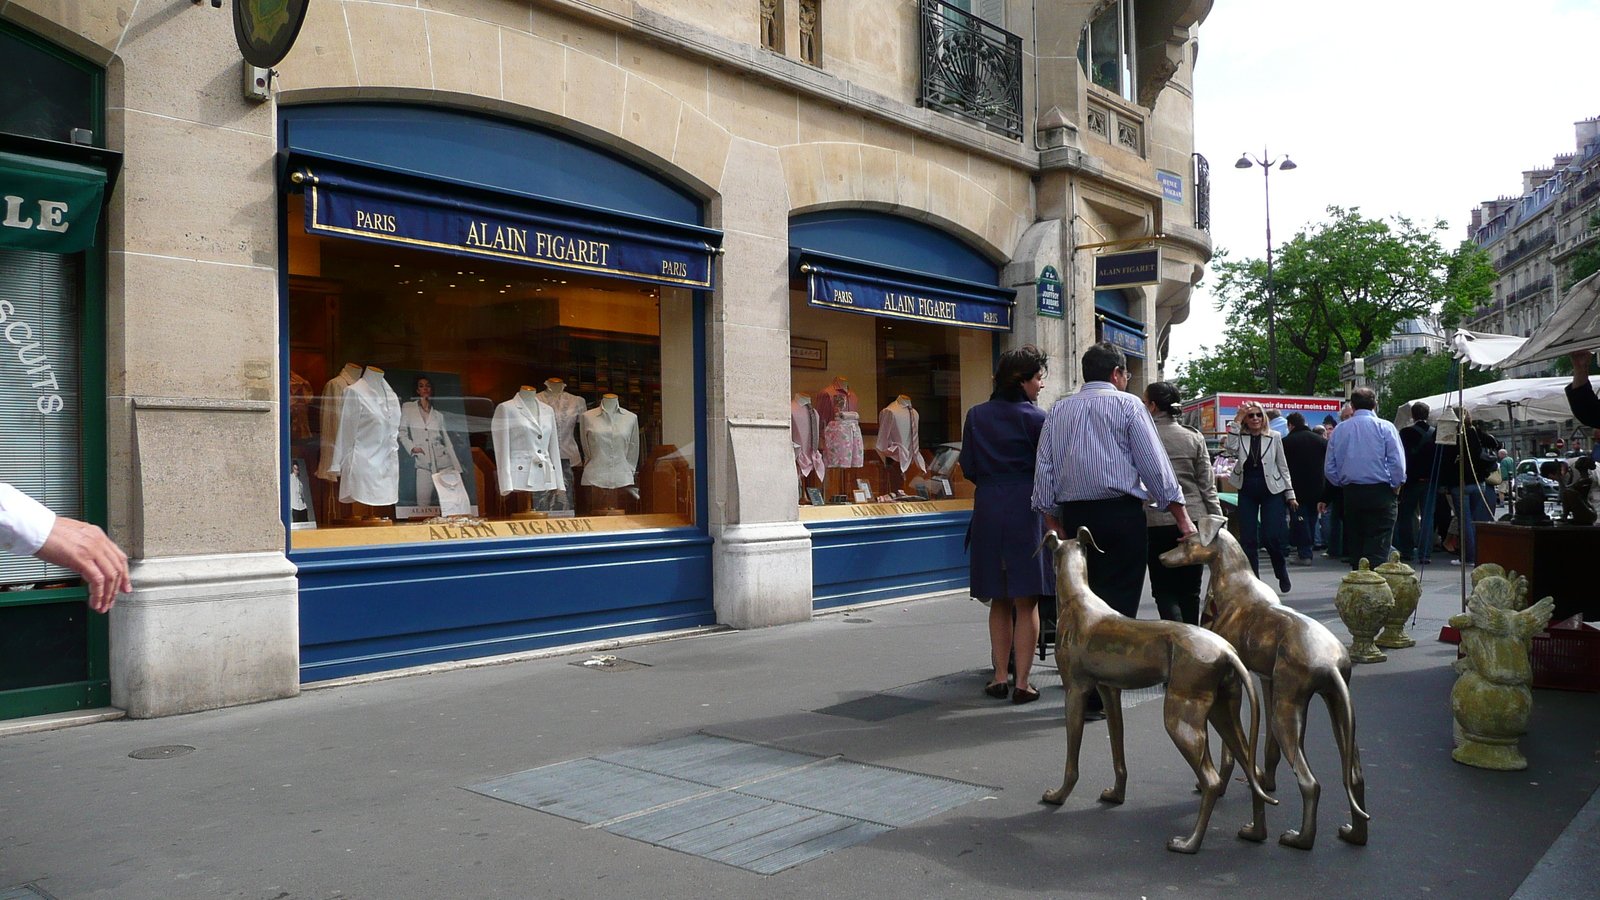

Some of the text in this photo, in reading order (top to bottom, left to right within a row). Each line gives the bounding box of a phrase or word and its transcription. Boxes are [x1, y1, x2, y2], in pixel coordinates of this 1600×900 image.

[356, 210, 687, 277] PARIS ALAIN FIGARET PARIS
[1098, 264, 1156, 276] ALAIN FIGARET
[834, 289, 999, 324] PARIS ALAIN FIGARET PARIS
[1323, 403, 1338, 411] cher
[851, 501, 939, 517] ALAIN FIGARET
[428, 518, 593, 541] ALAIN FIGARET
